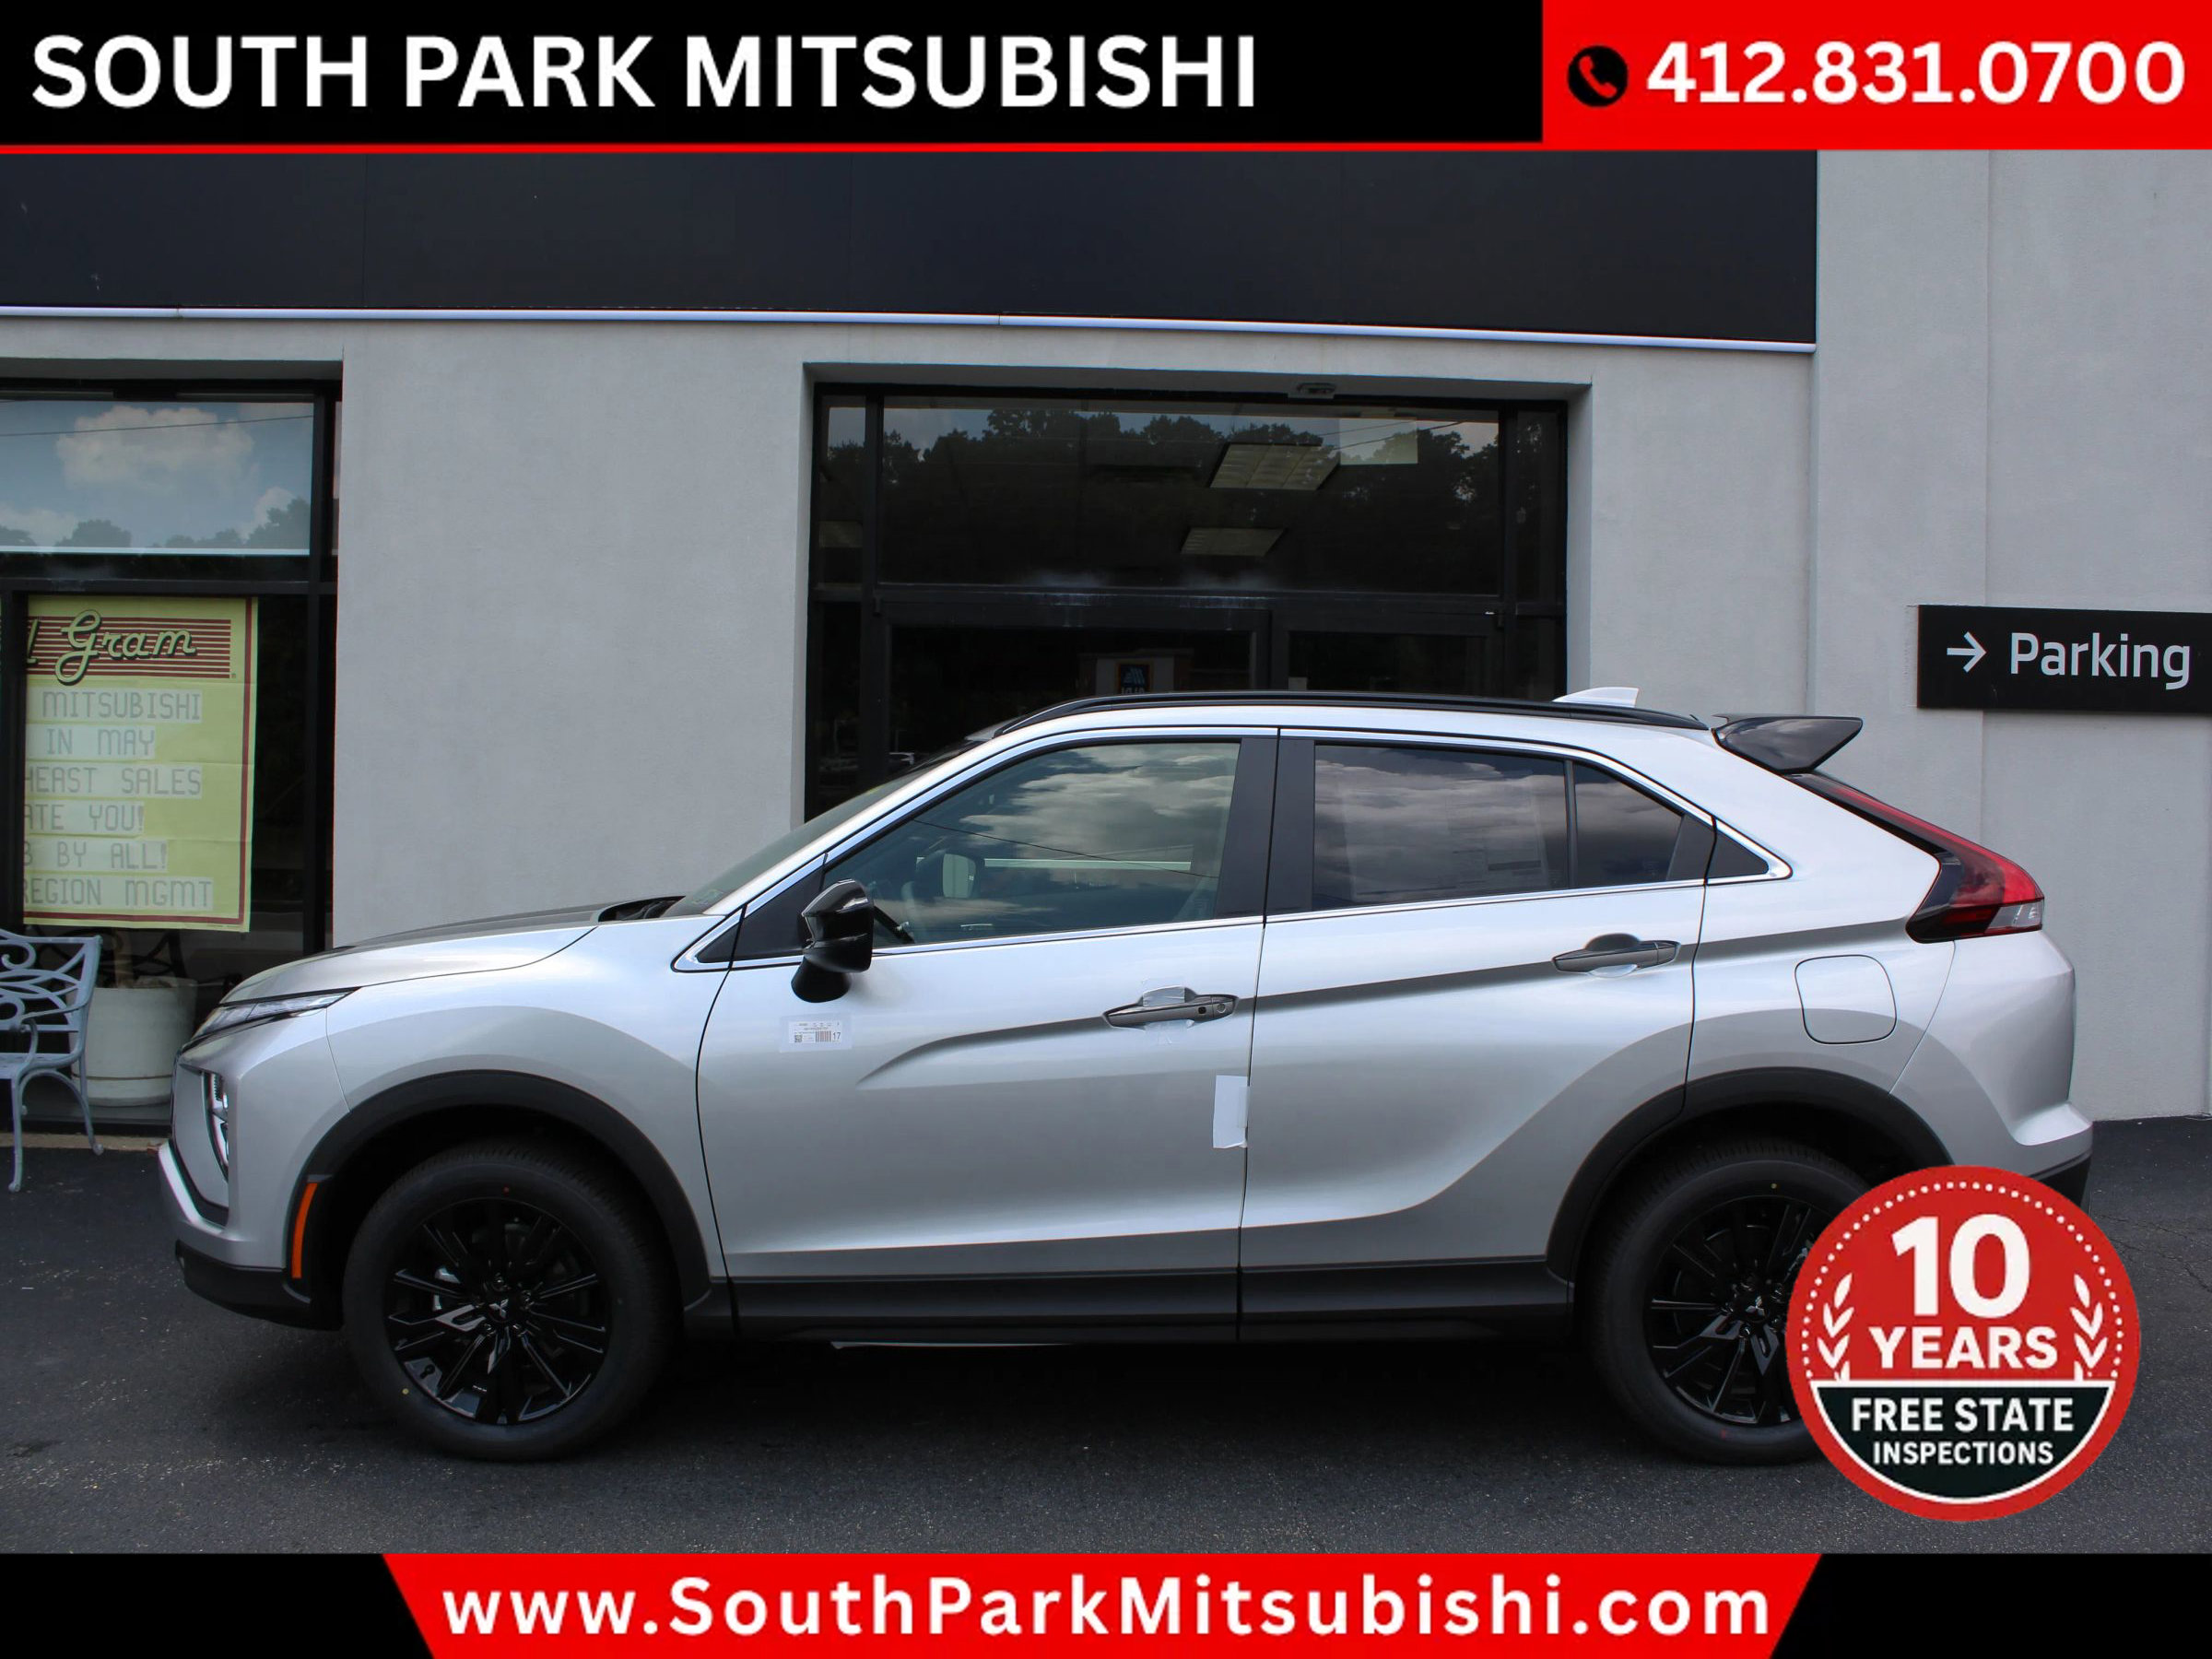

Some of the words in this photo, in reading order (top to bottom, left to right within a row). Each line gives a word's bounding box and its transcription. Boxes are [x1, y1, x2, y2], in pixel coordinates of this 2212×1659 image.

[54, 609, 198, 686] Gram
[2010, 632, 2190, 690] Parking
[41, 689, 201, 721] MITSUBISHI
[46, 728, 73, 755] IN
[97, 728, 156, 756] MAY
[121, 768, 202, 796] SALES
[88, 805, 144, 831] YOU!
[57, 841, 87, 868] BY
[111, 842, 167, 870] ALL!
[124, 879, 212, 908] MGMT
